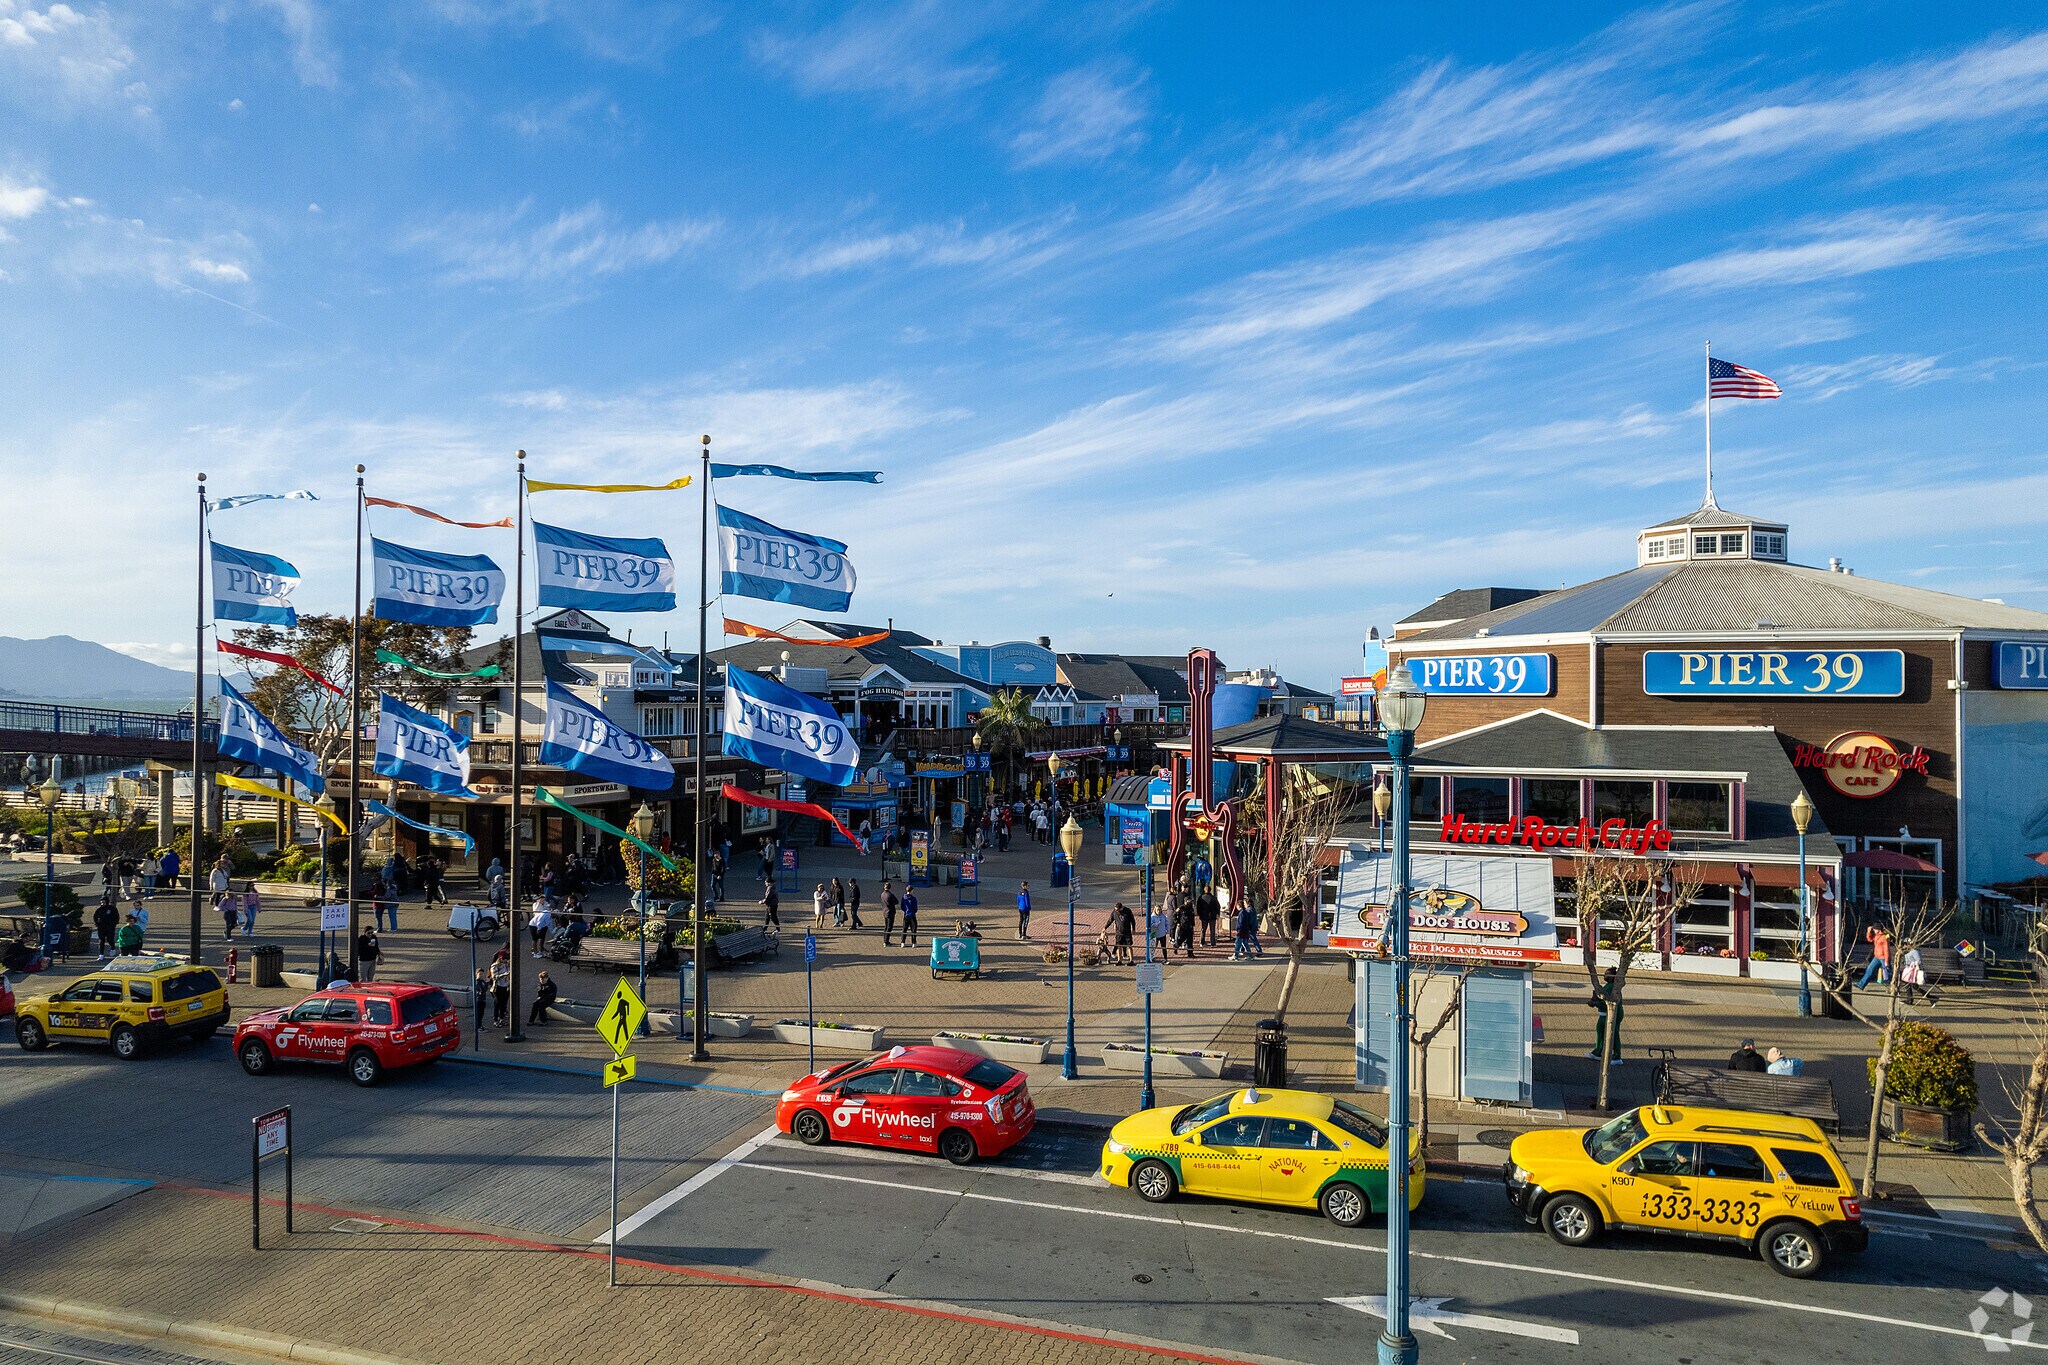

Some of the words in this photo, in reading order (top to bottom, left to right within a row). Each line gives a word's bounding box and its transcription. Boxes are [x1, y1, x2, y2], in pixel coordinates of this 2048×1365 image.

[554, 620, 567, 629] EAGLE
[581, 621, 592, 630] CAFE
[1422, 658, 1485, 688] PIER
[1488, 656, 1527, 693] 39
[1679, 653, 1794, 686] PIER
[1803, 652, 1864, 693] 39
[860, 688, 874, 698] FOG
[875, 687, 904, 697] HARBOR
[966, 759, 976, 768] 39
[980, 760, 990, 769] 39
[1793, 745, 1860, 769] Hard
[1862, 745, 1930, 775] Rock
[330, 780, 380, 789] SPORWEAR
[1844, 776, 1879, 787] CAFE
[476, 785, 492, 795] Only
[500, 785, 513, 794] San
[574, 784, 619, 795] SPORTSWEAR
[1439, 813, 1518, 845] Hard
[1520, 815, 1597, 853] Rock
[1600, 817, 1673, 856] Cafe
[1413, 914, 1450, 929] DOG
[1453, 916, 1511, 932] HOUSE
[1479, 947, 1523, 958] SAUSAGES
[49, 1014, 79, 1027] YoTaxi
[297, 1034, 347, 1049] Flywheel
[861, 1107, 935, 1129] Flywheel
[258, 1124, 268, 1135] NO
[267, 1119, 286, 1131] STOPPING
[266, 1130, 279, 1140] ANY
[919, 1135, 932, 1143] taxi
[266, 1137, 279, 1147] TIME
[1160, 1142, 1179, 1152] K789
[1193, 1162, 1241, 1170] 415-648-4444
[1269, 1156, 1309, 1174] NATIONAL
[1612, 1176, 1635, 1187] K907
[1795, 1185, 1824, 1194] FRANCISCO
[1825, 1187, 1847, 1196] TAXICAB
[1648, 1193, 1761, 1228] 333-3333
[1801, 1200, 1835, 1212] YELLOW
